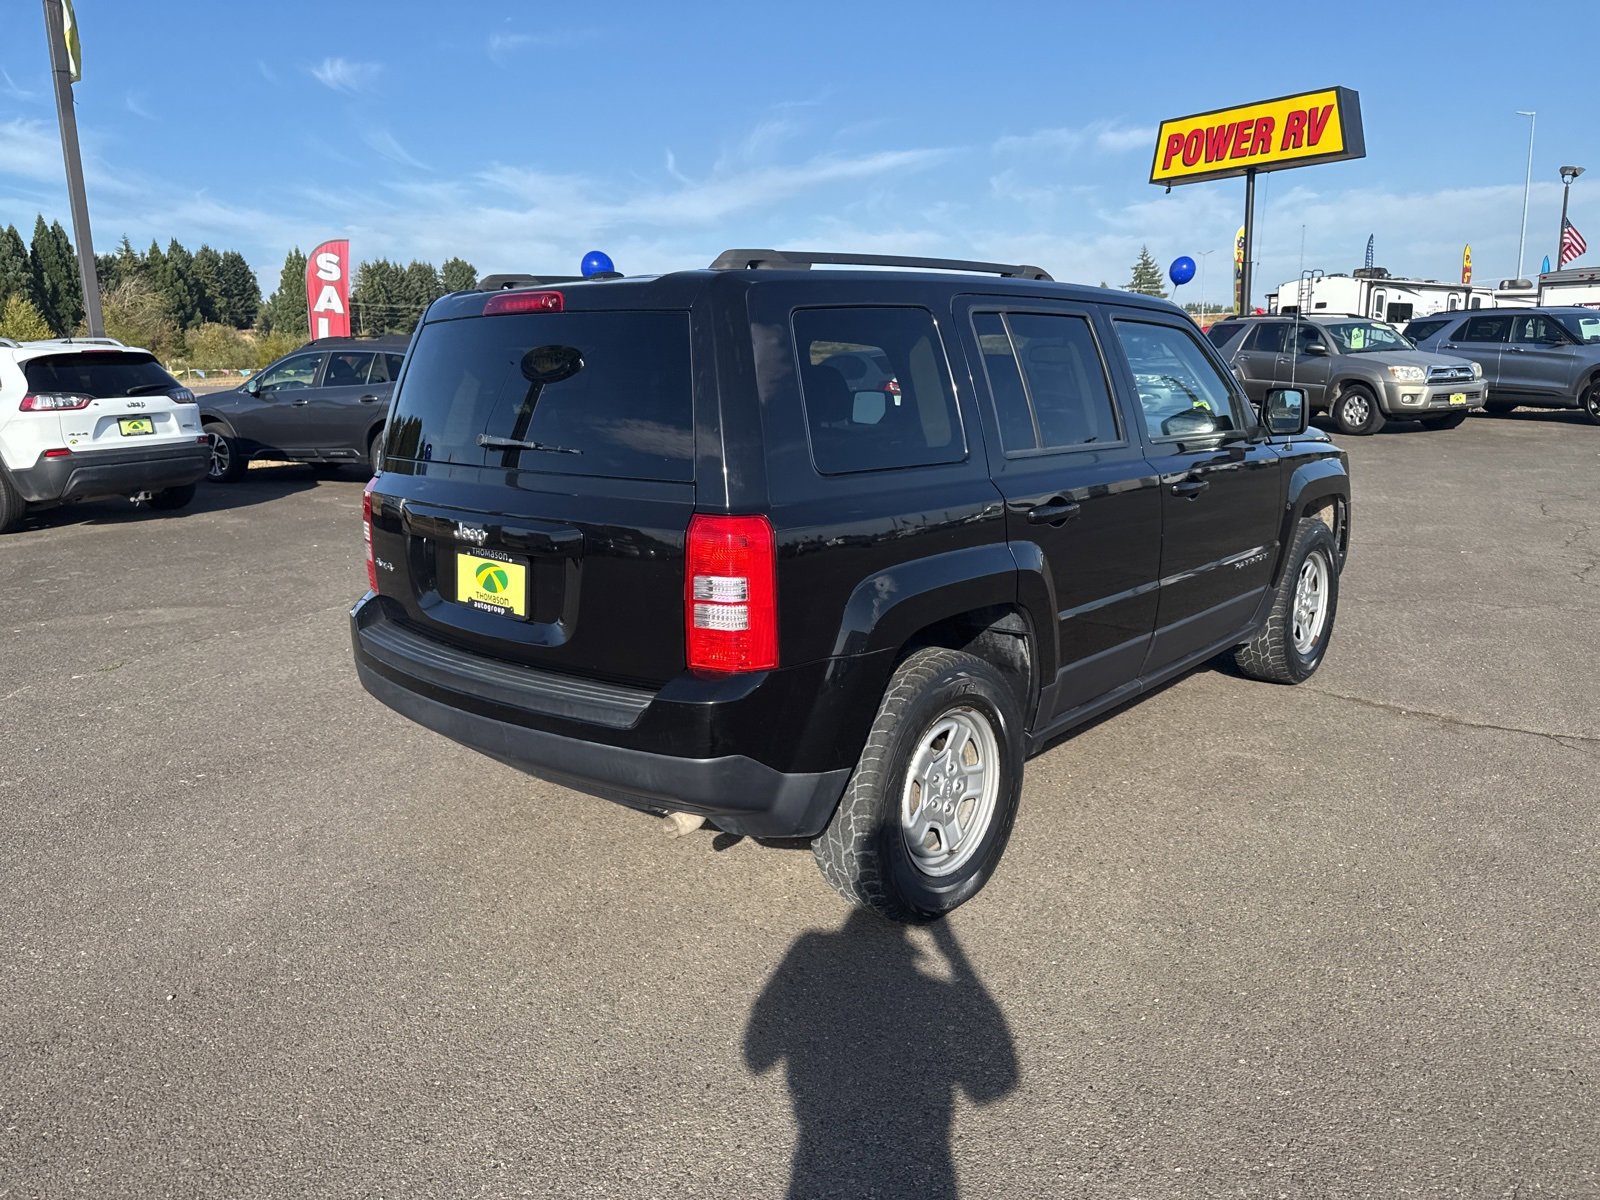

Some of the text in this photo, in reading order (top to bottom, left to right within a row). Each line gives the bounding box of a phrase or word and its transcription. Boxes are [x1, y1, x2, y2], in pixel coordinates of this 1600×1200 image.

[1162, 104, 1335, 170] POWER RV
[126, 401, 147, 409] Jeep
[453, 522, 488, 546] Jeep
[473, 601, 505, 615] autogroup
